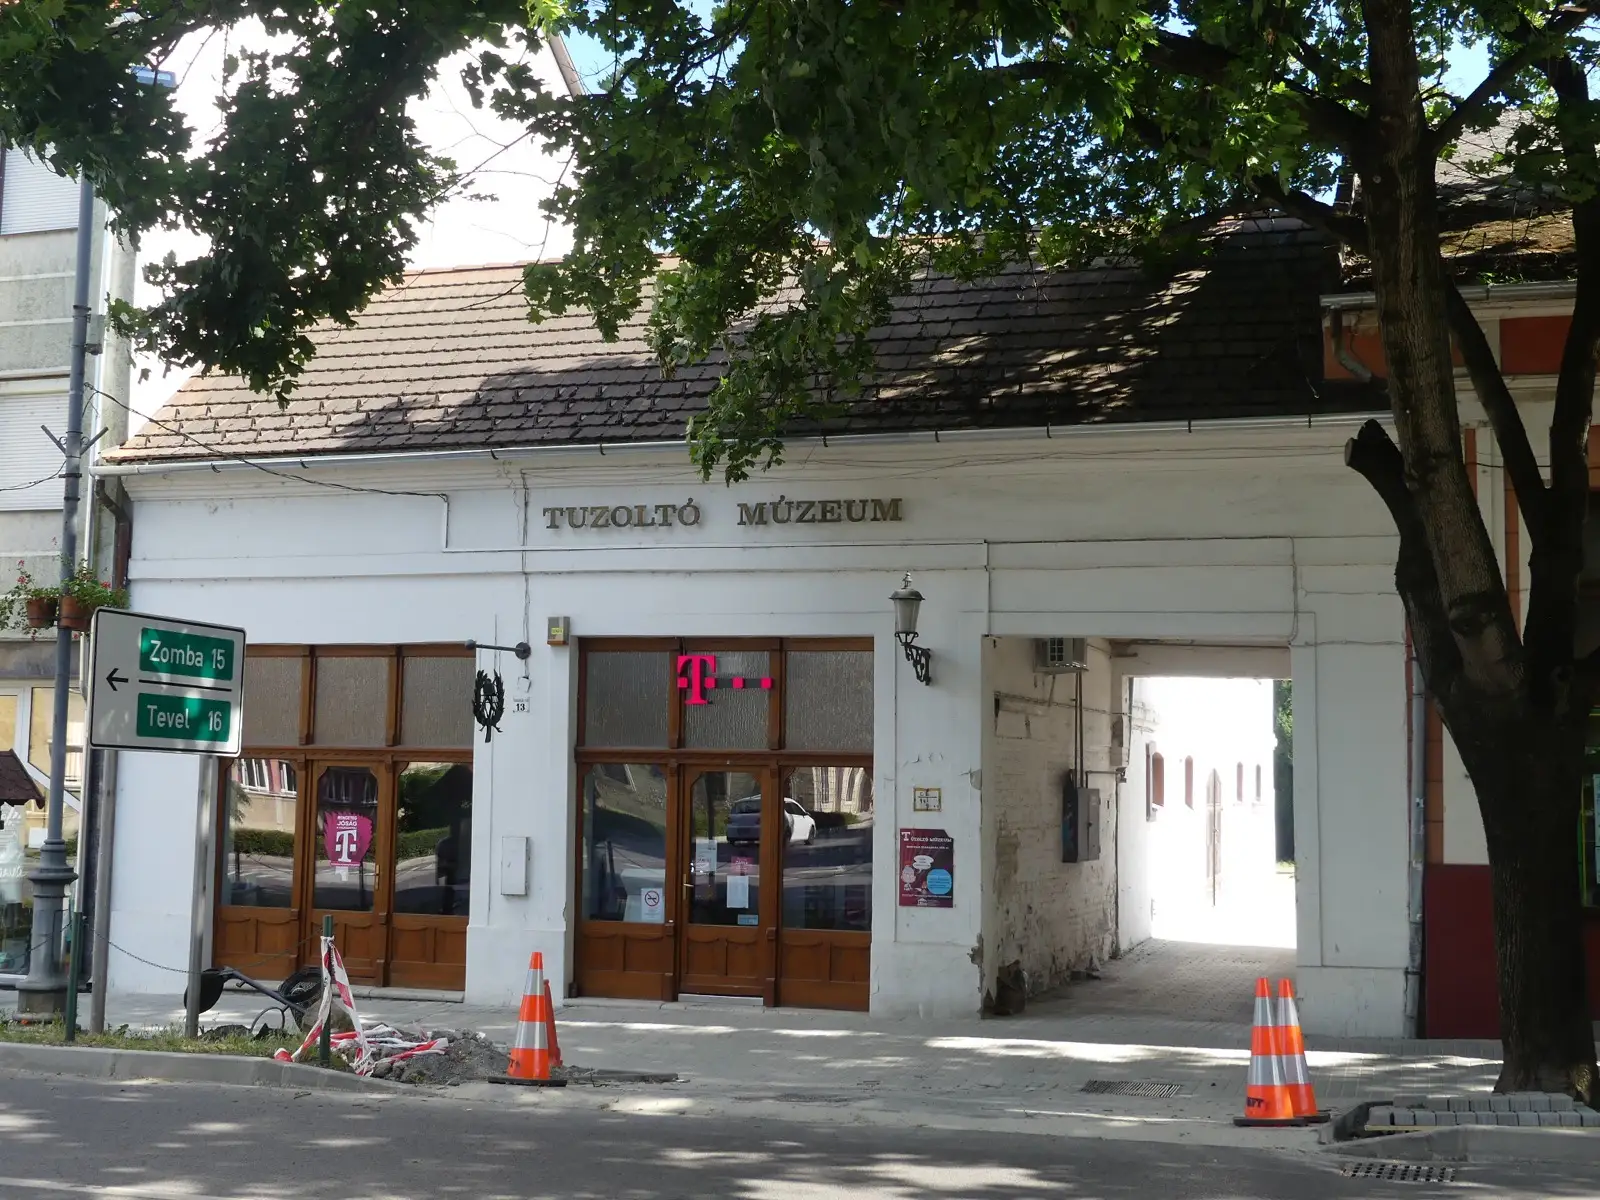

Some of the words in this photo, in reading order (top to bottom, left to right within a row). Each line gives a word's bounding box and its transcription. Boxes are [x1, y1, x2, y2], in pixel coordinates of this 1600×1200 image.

[543, 498, 700, 529] TUZOLTÓ
[737, 495, 903, 526] MÚZEUM
[149, 640, 204, 667] Zomba
[211, 648, 226, 670] 15
[147, 704, 190, 729] Tevel
[208, 710, 222, 731] 16
[516, 703, 526, 712] 13
